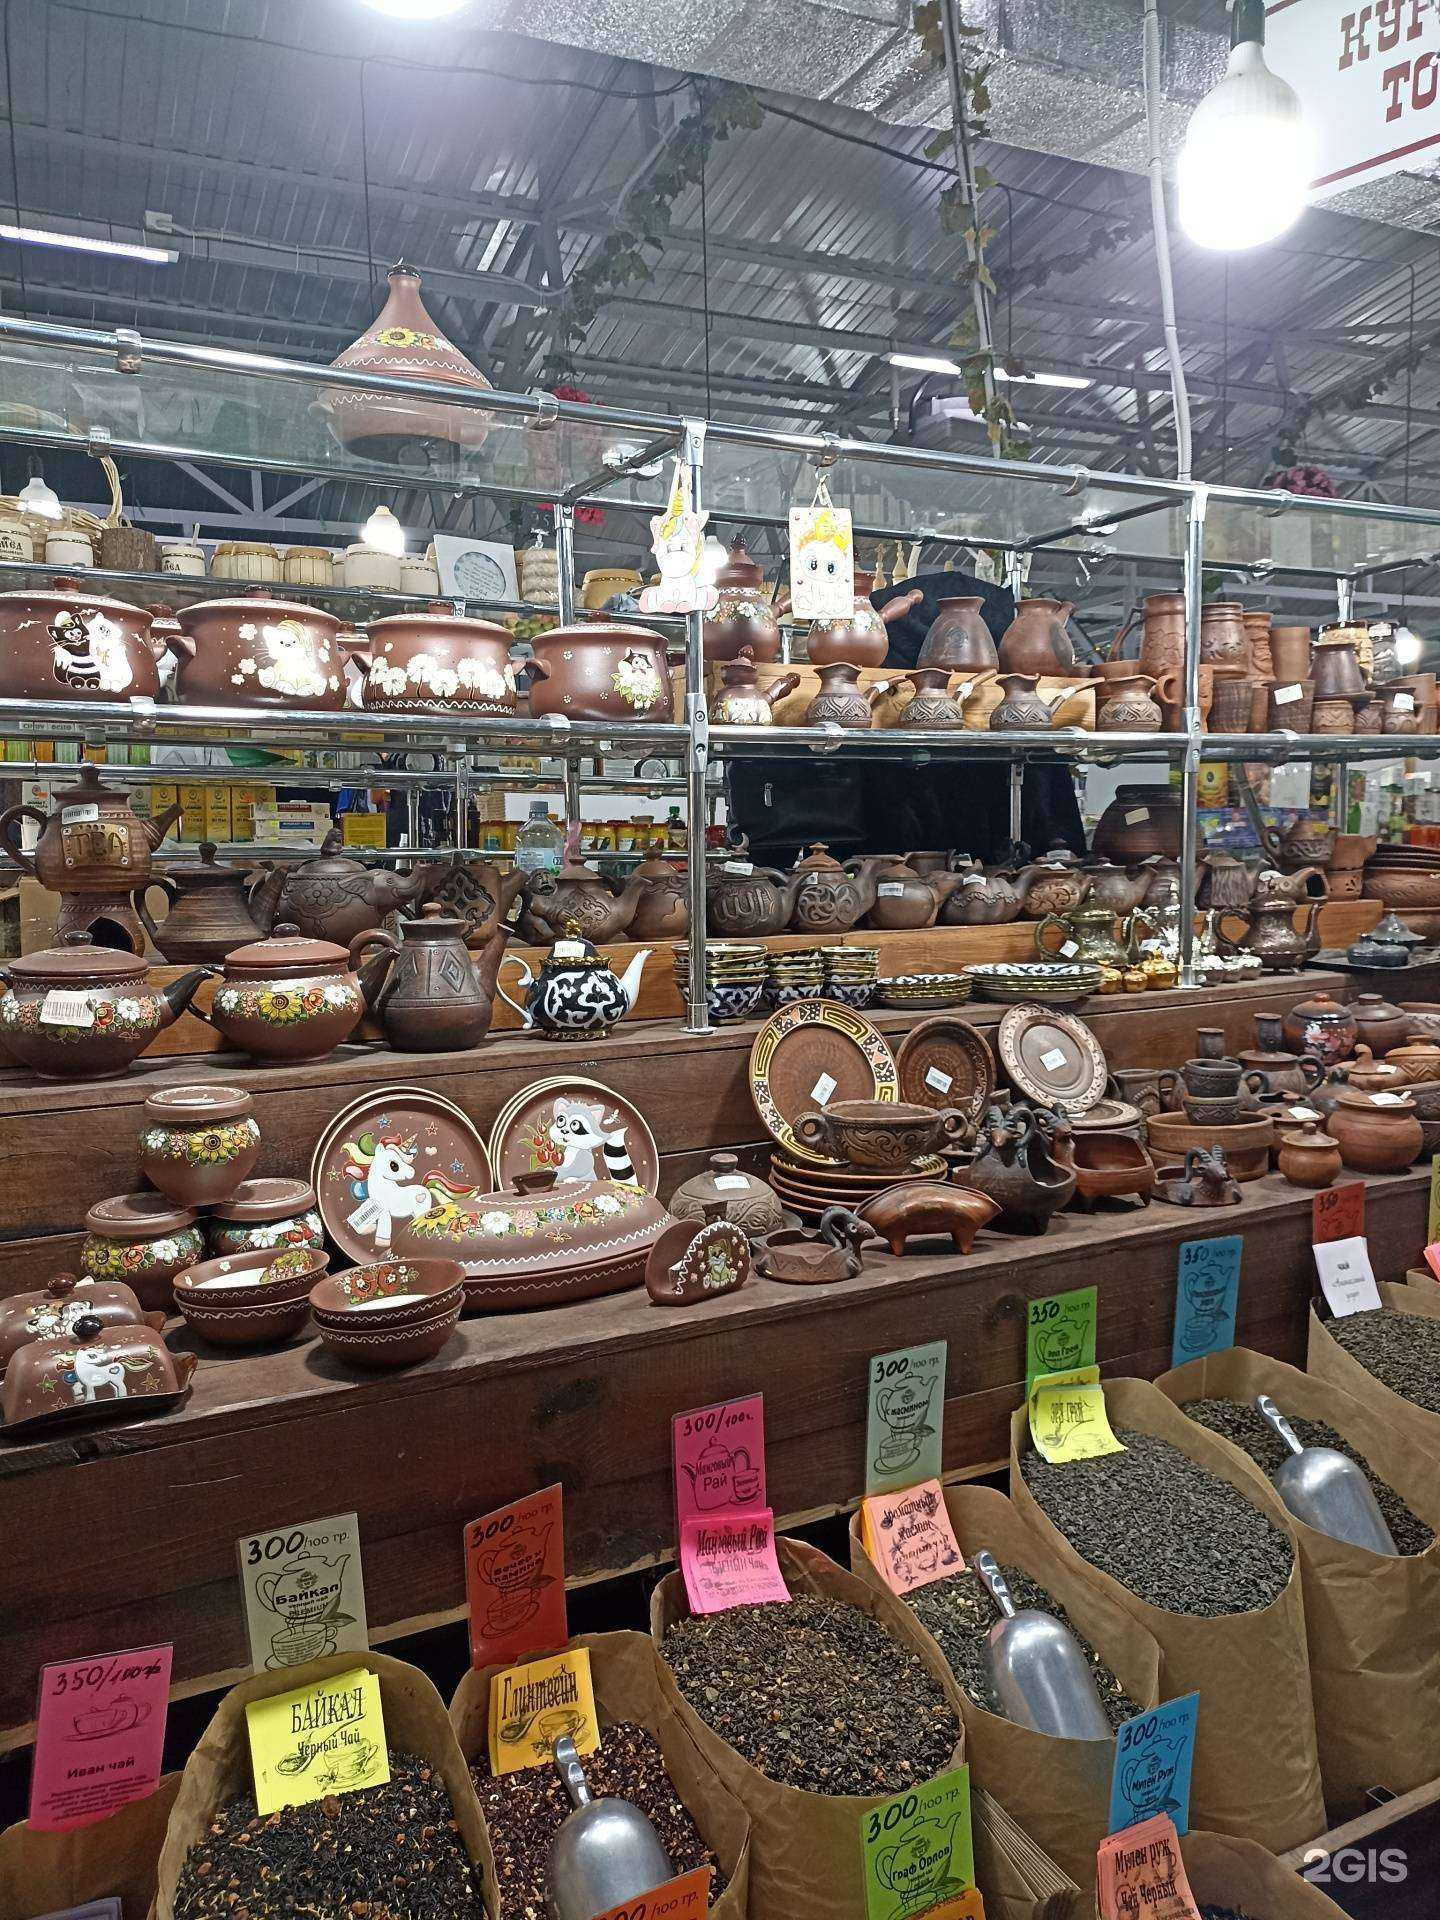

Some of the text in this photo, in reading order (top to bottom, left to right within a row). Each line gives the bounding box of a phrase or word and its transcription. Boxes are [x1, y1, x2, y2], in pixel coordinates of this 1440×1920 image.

[703, 1473, 728, 1492] Рай
[333, 1530, 349, 1545] гр.
[275, 1583, 339, 1605] Байкал
[291, 1687, 363, 1734] БАЙКАЛ
[297, 1728, 361, 1757] Черный Чай
[67, 1756, 135, 1780] Иван чай
[918, 1845, 950, 1870] Орлов
[1114, 1845, 1148, 1878] Мулен
